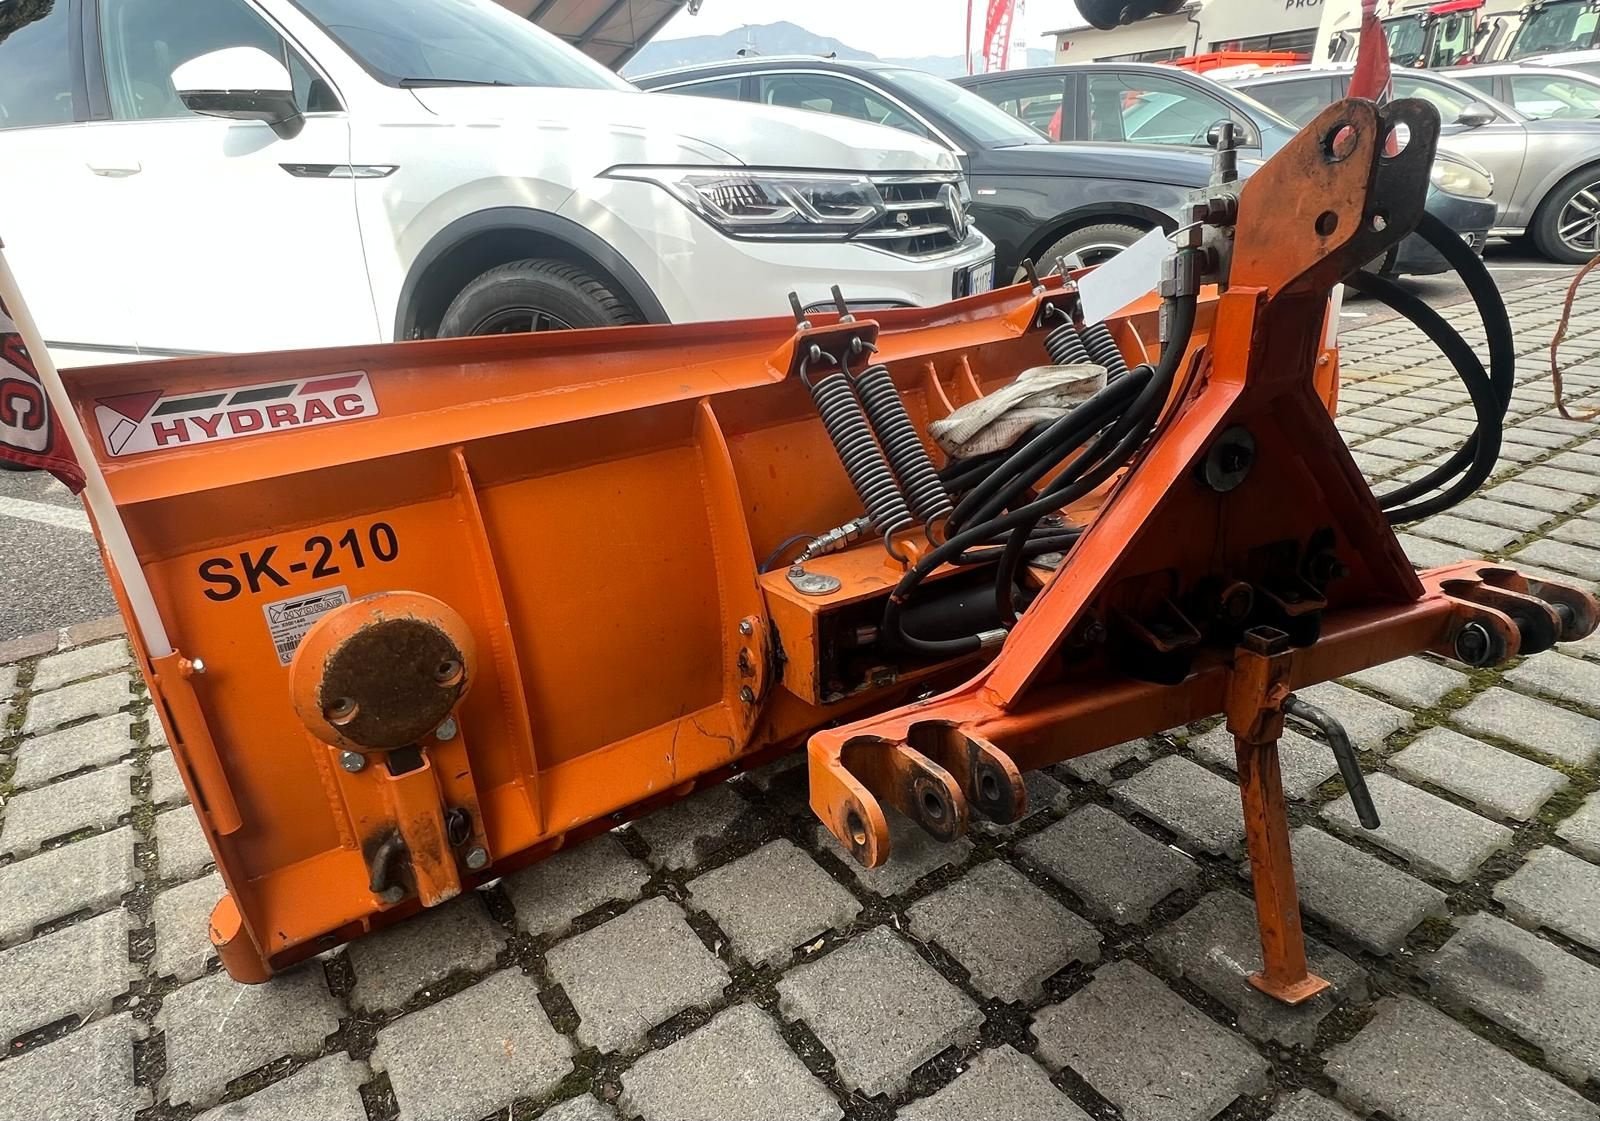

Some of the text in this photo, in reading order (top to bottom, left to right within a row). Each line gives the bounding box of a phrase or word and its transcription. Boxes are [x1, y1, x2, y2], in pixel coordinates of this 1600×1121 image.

[152, 394, 365, 446] HYDRAC
[199, 522, 399, 602] SK-210
[283, 597, 343, 620] HYDRAC
